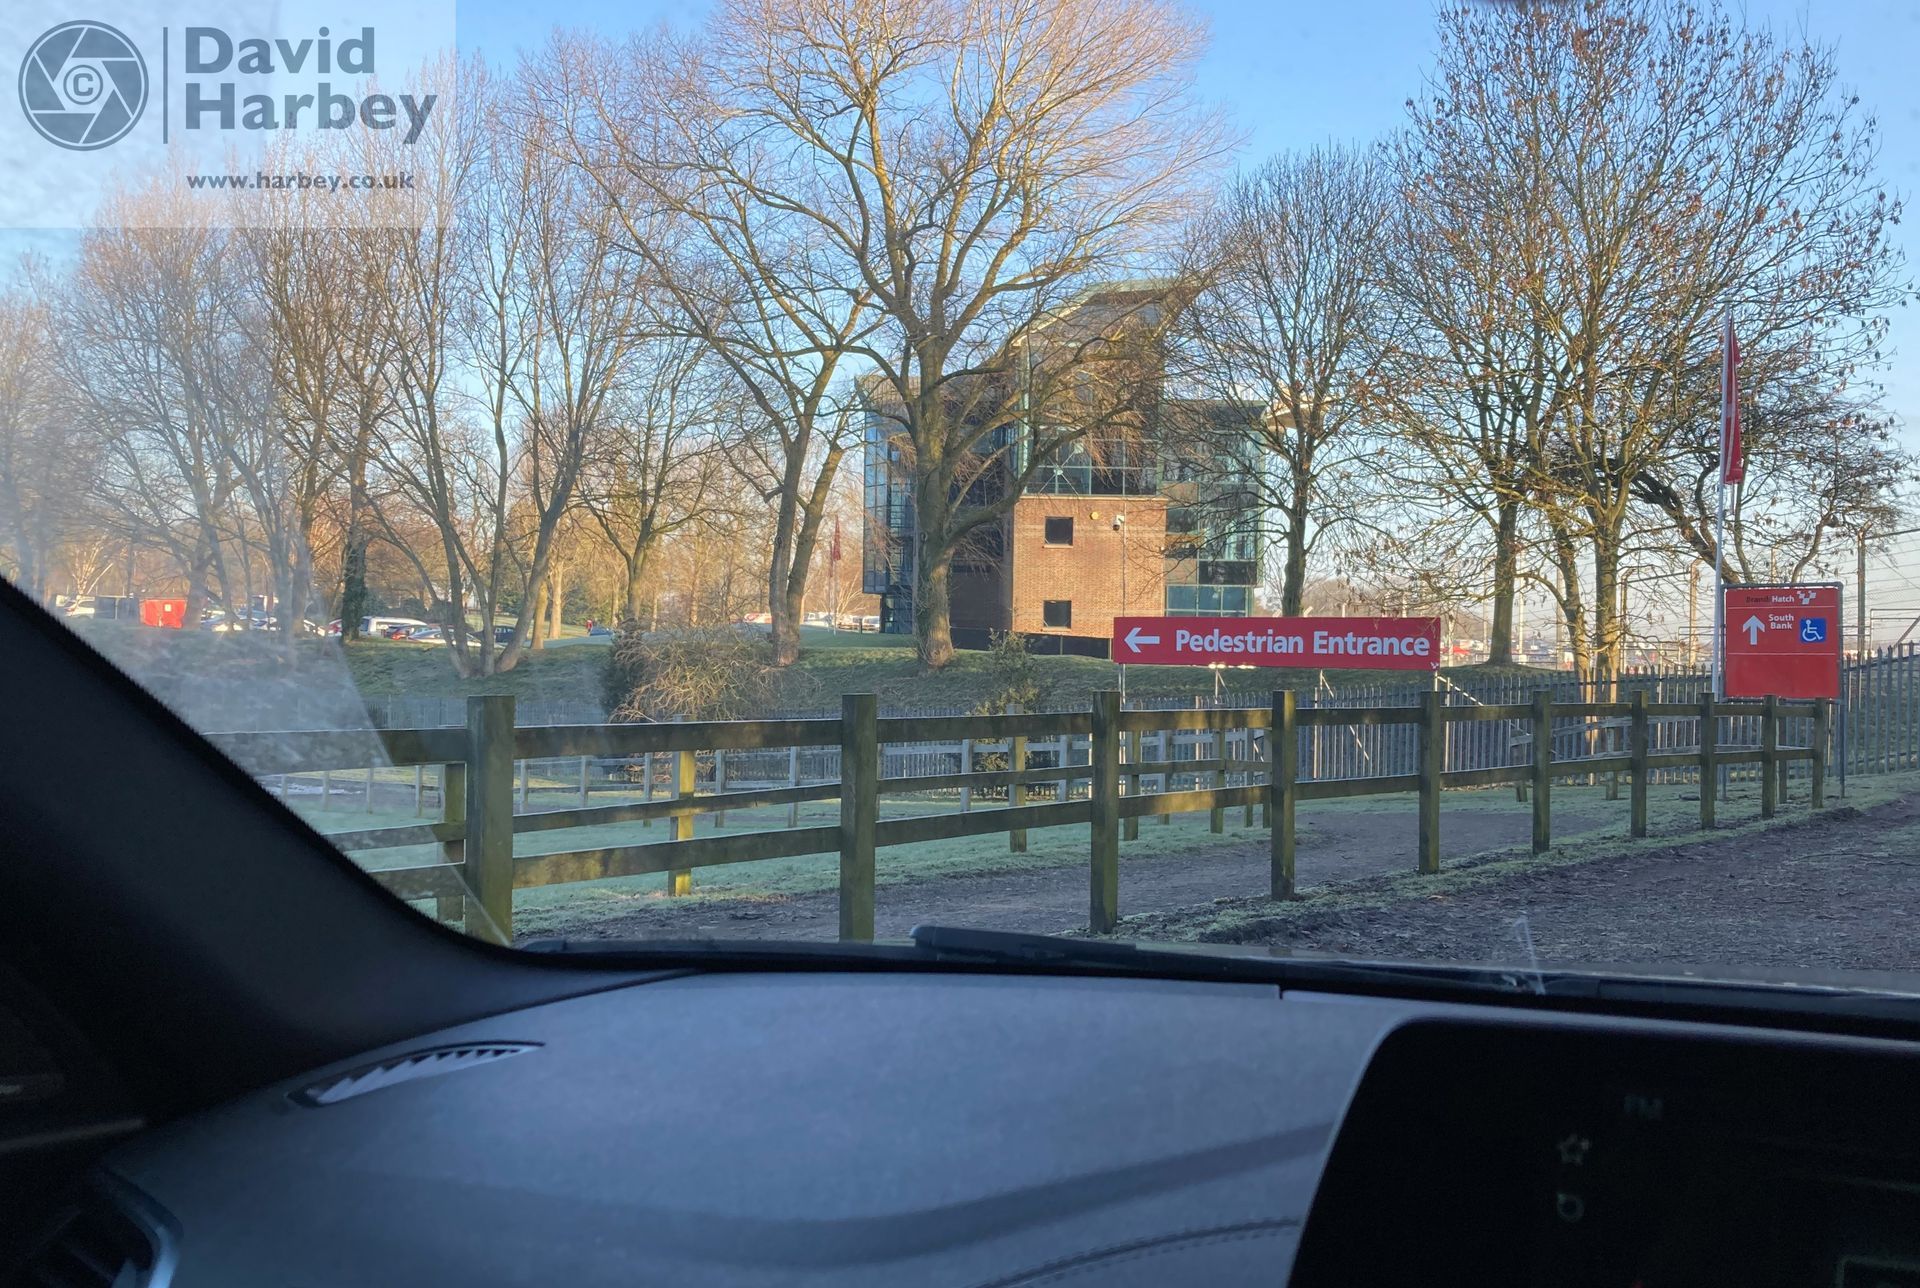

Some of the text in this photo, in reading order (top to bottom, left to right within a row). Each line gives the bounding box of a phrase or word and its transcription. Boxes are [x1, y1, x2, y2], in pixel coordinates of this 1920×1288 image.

[1771, 595, 1795, 603] Hatch
[1768, 613, 1795, 622] South
[1770, 622, 1793, 630] Bank
[1175, 628, 1430, 657] Pedestrian Entrance
